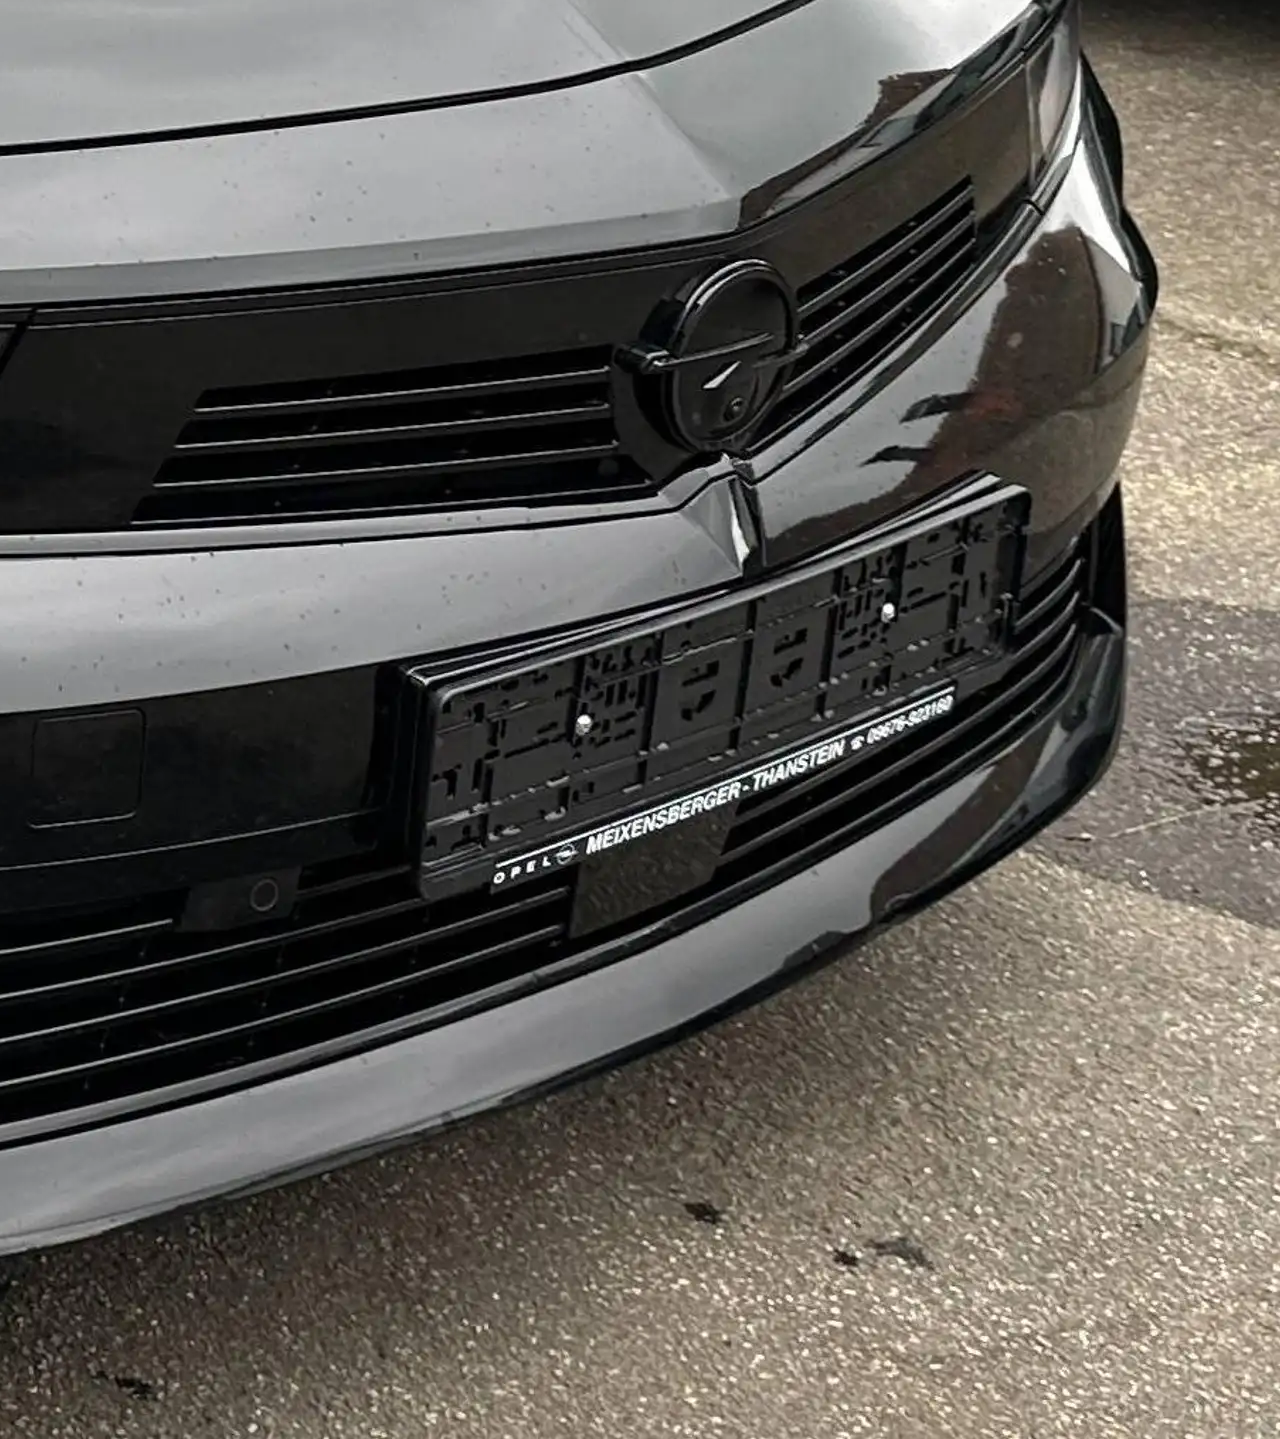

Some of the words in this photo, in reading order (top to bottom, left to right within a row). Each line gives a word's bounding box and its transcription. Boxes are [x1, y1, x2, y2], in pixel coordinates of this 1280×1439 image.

[493, 855, 552, 885] OPEL
[585, 781, 742, 856] MEIXENSBERGER
[752, 738, 846, 792] THANSTEIN
